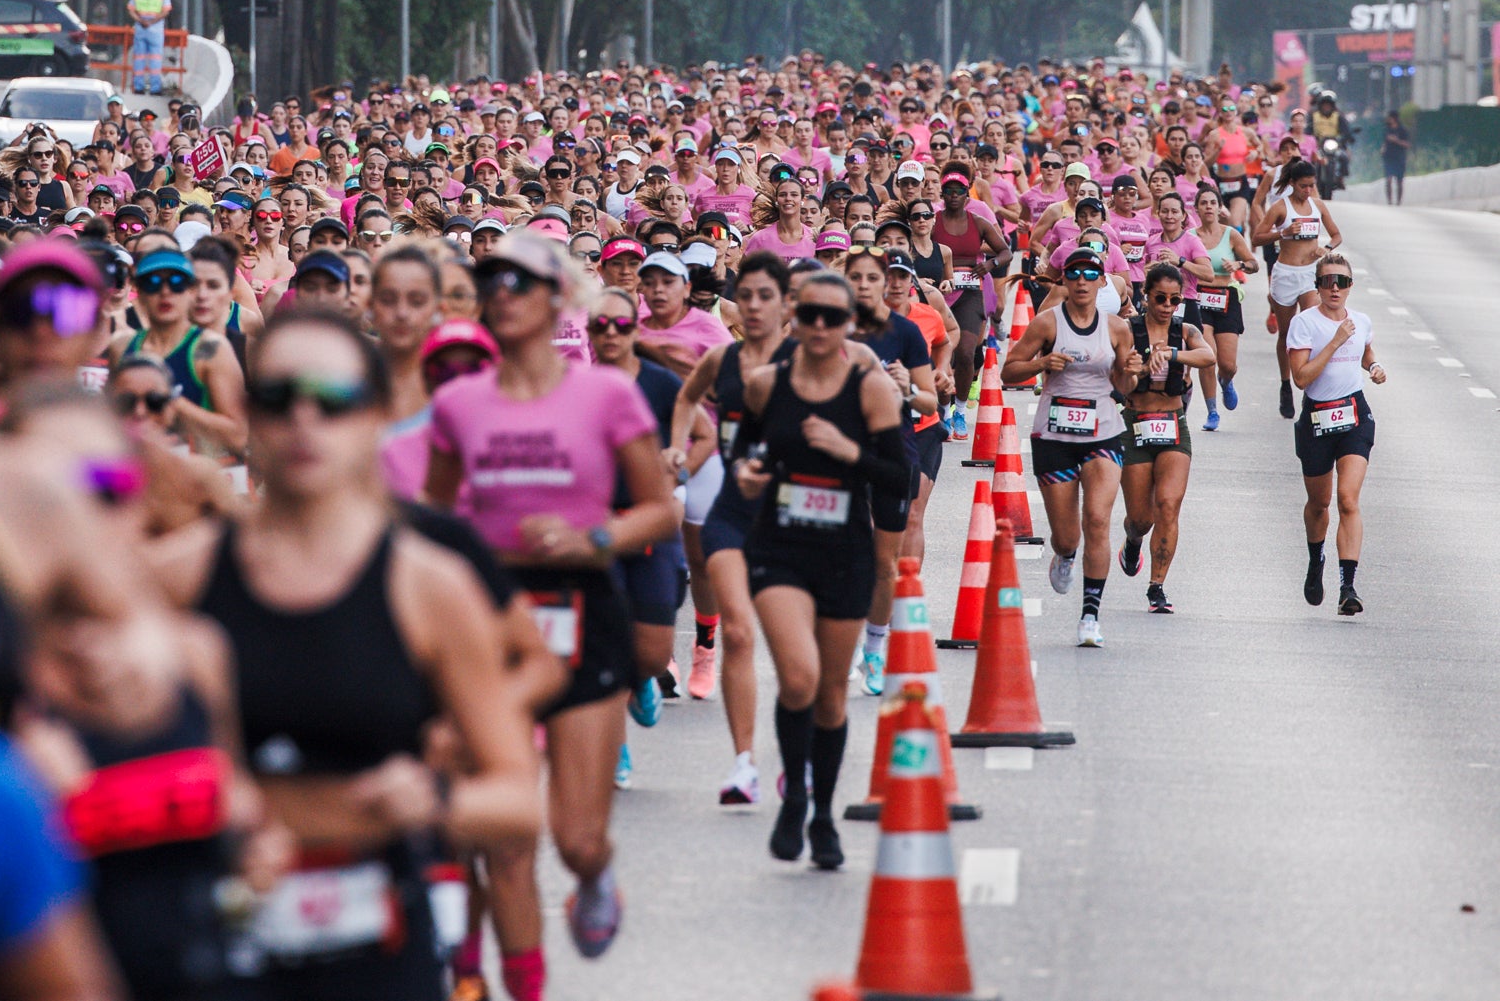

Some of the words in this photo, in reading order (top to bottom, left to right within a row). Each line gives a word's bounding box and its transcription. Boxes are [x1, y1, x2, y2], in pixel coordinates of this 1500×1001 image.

[196, 141, 214, 162] 1:50
[824, 235, 845, 244] HOKA
[614, 241, 635, 251] Jeep
[1206, 295, 1221, 304] 464
[1067, 410, 1088, 422] 537
[1330, 410, 1344, 422] 62
[1150, 422, 1167, 433] 167
